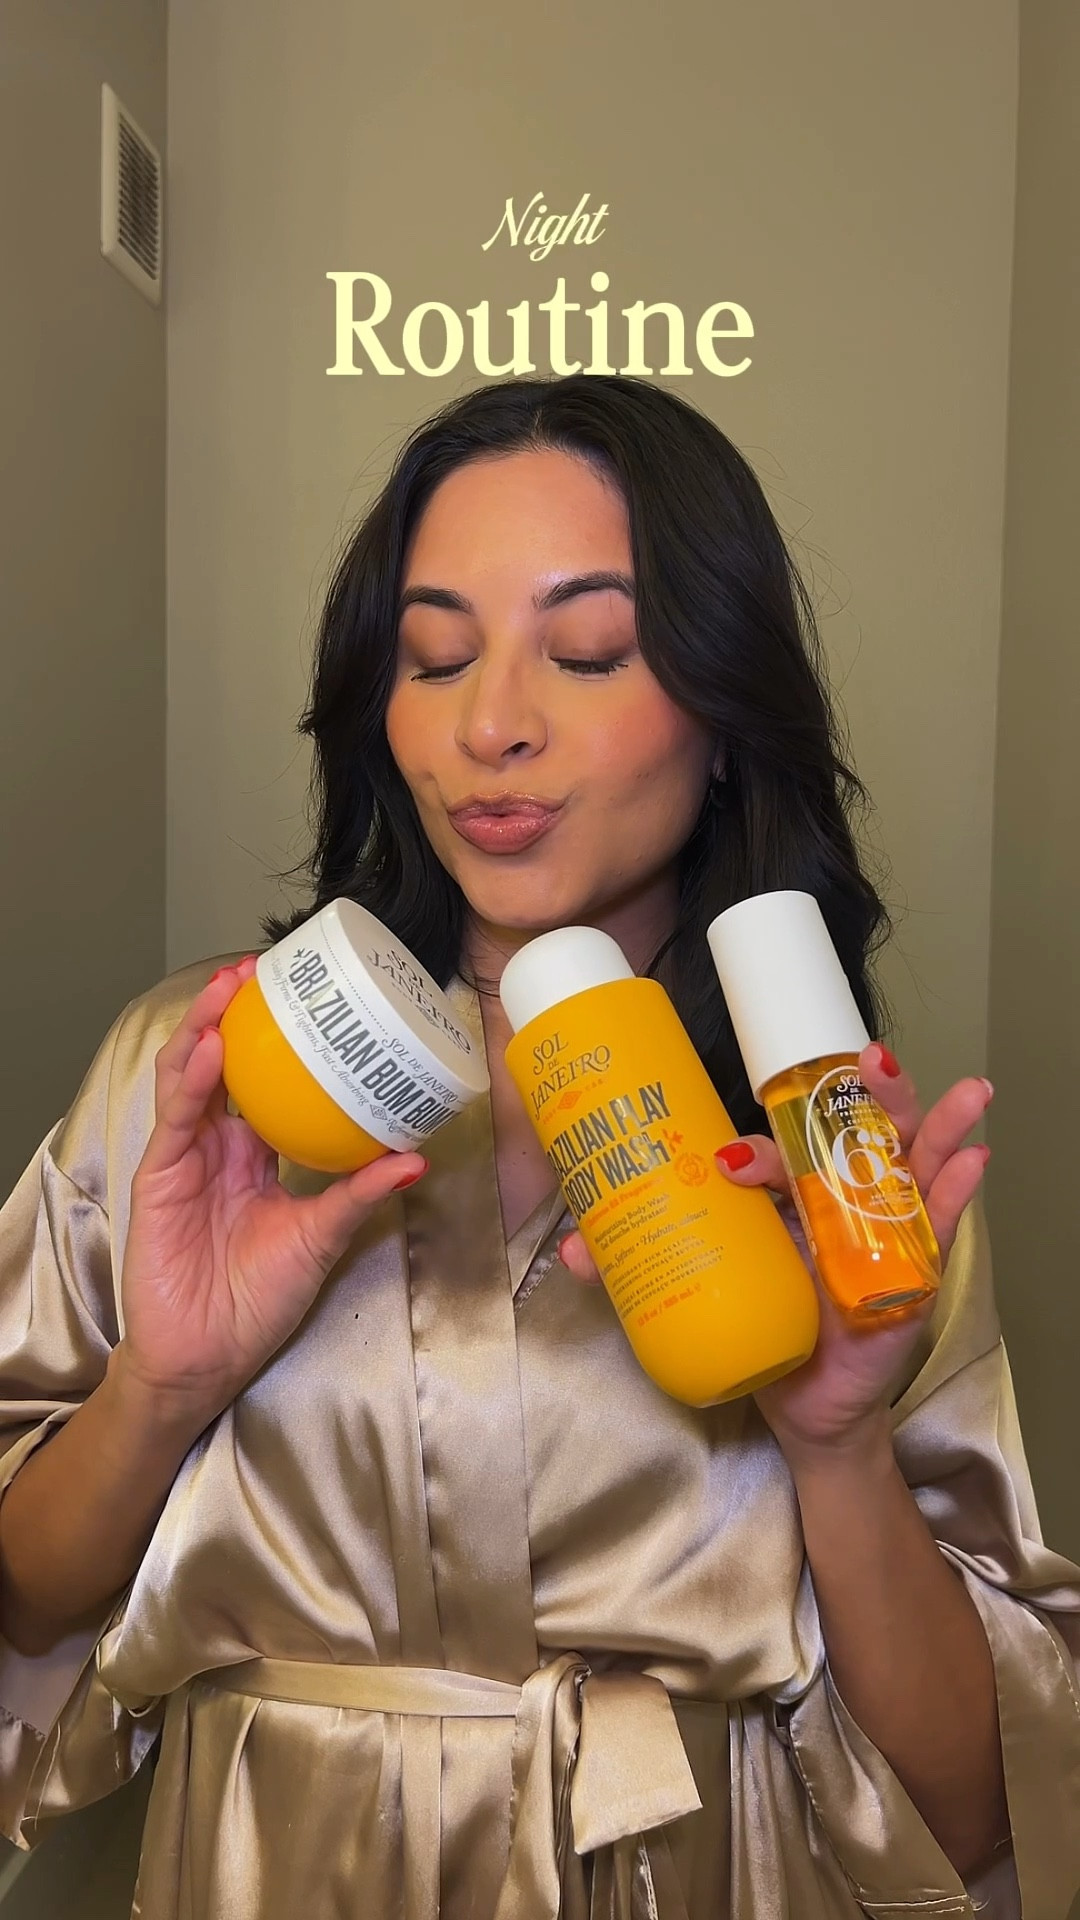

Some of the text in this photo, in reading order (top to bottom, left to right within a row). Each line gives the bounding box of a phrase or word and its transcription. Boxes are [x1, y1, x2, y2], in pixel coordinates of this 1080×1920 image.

[367, 948, 471, 1055] JANEIRO
[387, 950, 433, 998] SOL
[288, 951, 385, 1074] BRAZILIAN
[360, 1058, 424, 1115] BUM
[401, 1093, 455, 1136] BUM
[382, 1038, 459, 1104] SOL DE JANEIRO
[532, 1031, 569, 1075] SOL
[548, 1059, 559, 1071] DE
[314, 1045, 334, 1068] Fast
[331, 1064, 369, 1107] Absorbing
[530, 1045, 611, 1120] JANEIRO
[836, 1074, 864, 1093] SOL
[609, 1081, 671, 1136] PLAY
[595, 1131, 671, 1190] WASH
[832, 1124, 911, 1188] 62
[608, 1226, 630, 1244] douche
[631, 1205, 668, 1230] hydratant
[627, 1204, 646, 1220] Body
[647, 1192, 671, 1208] Wash
